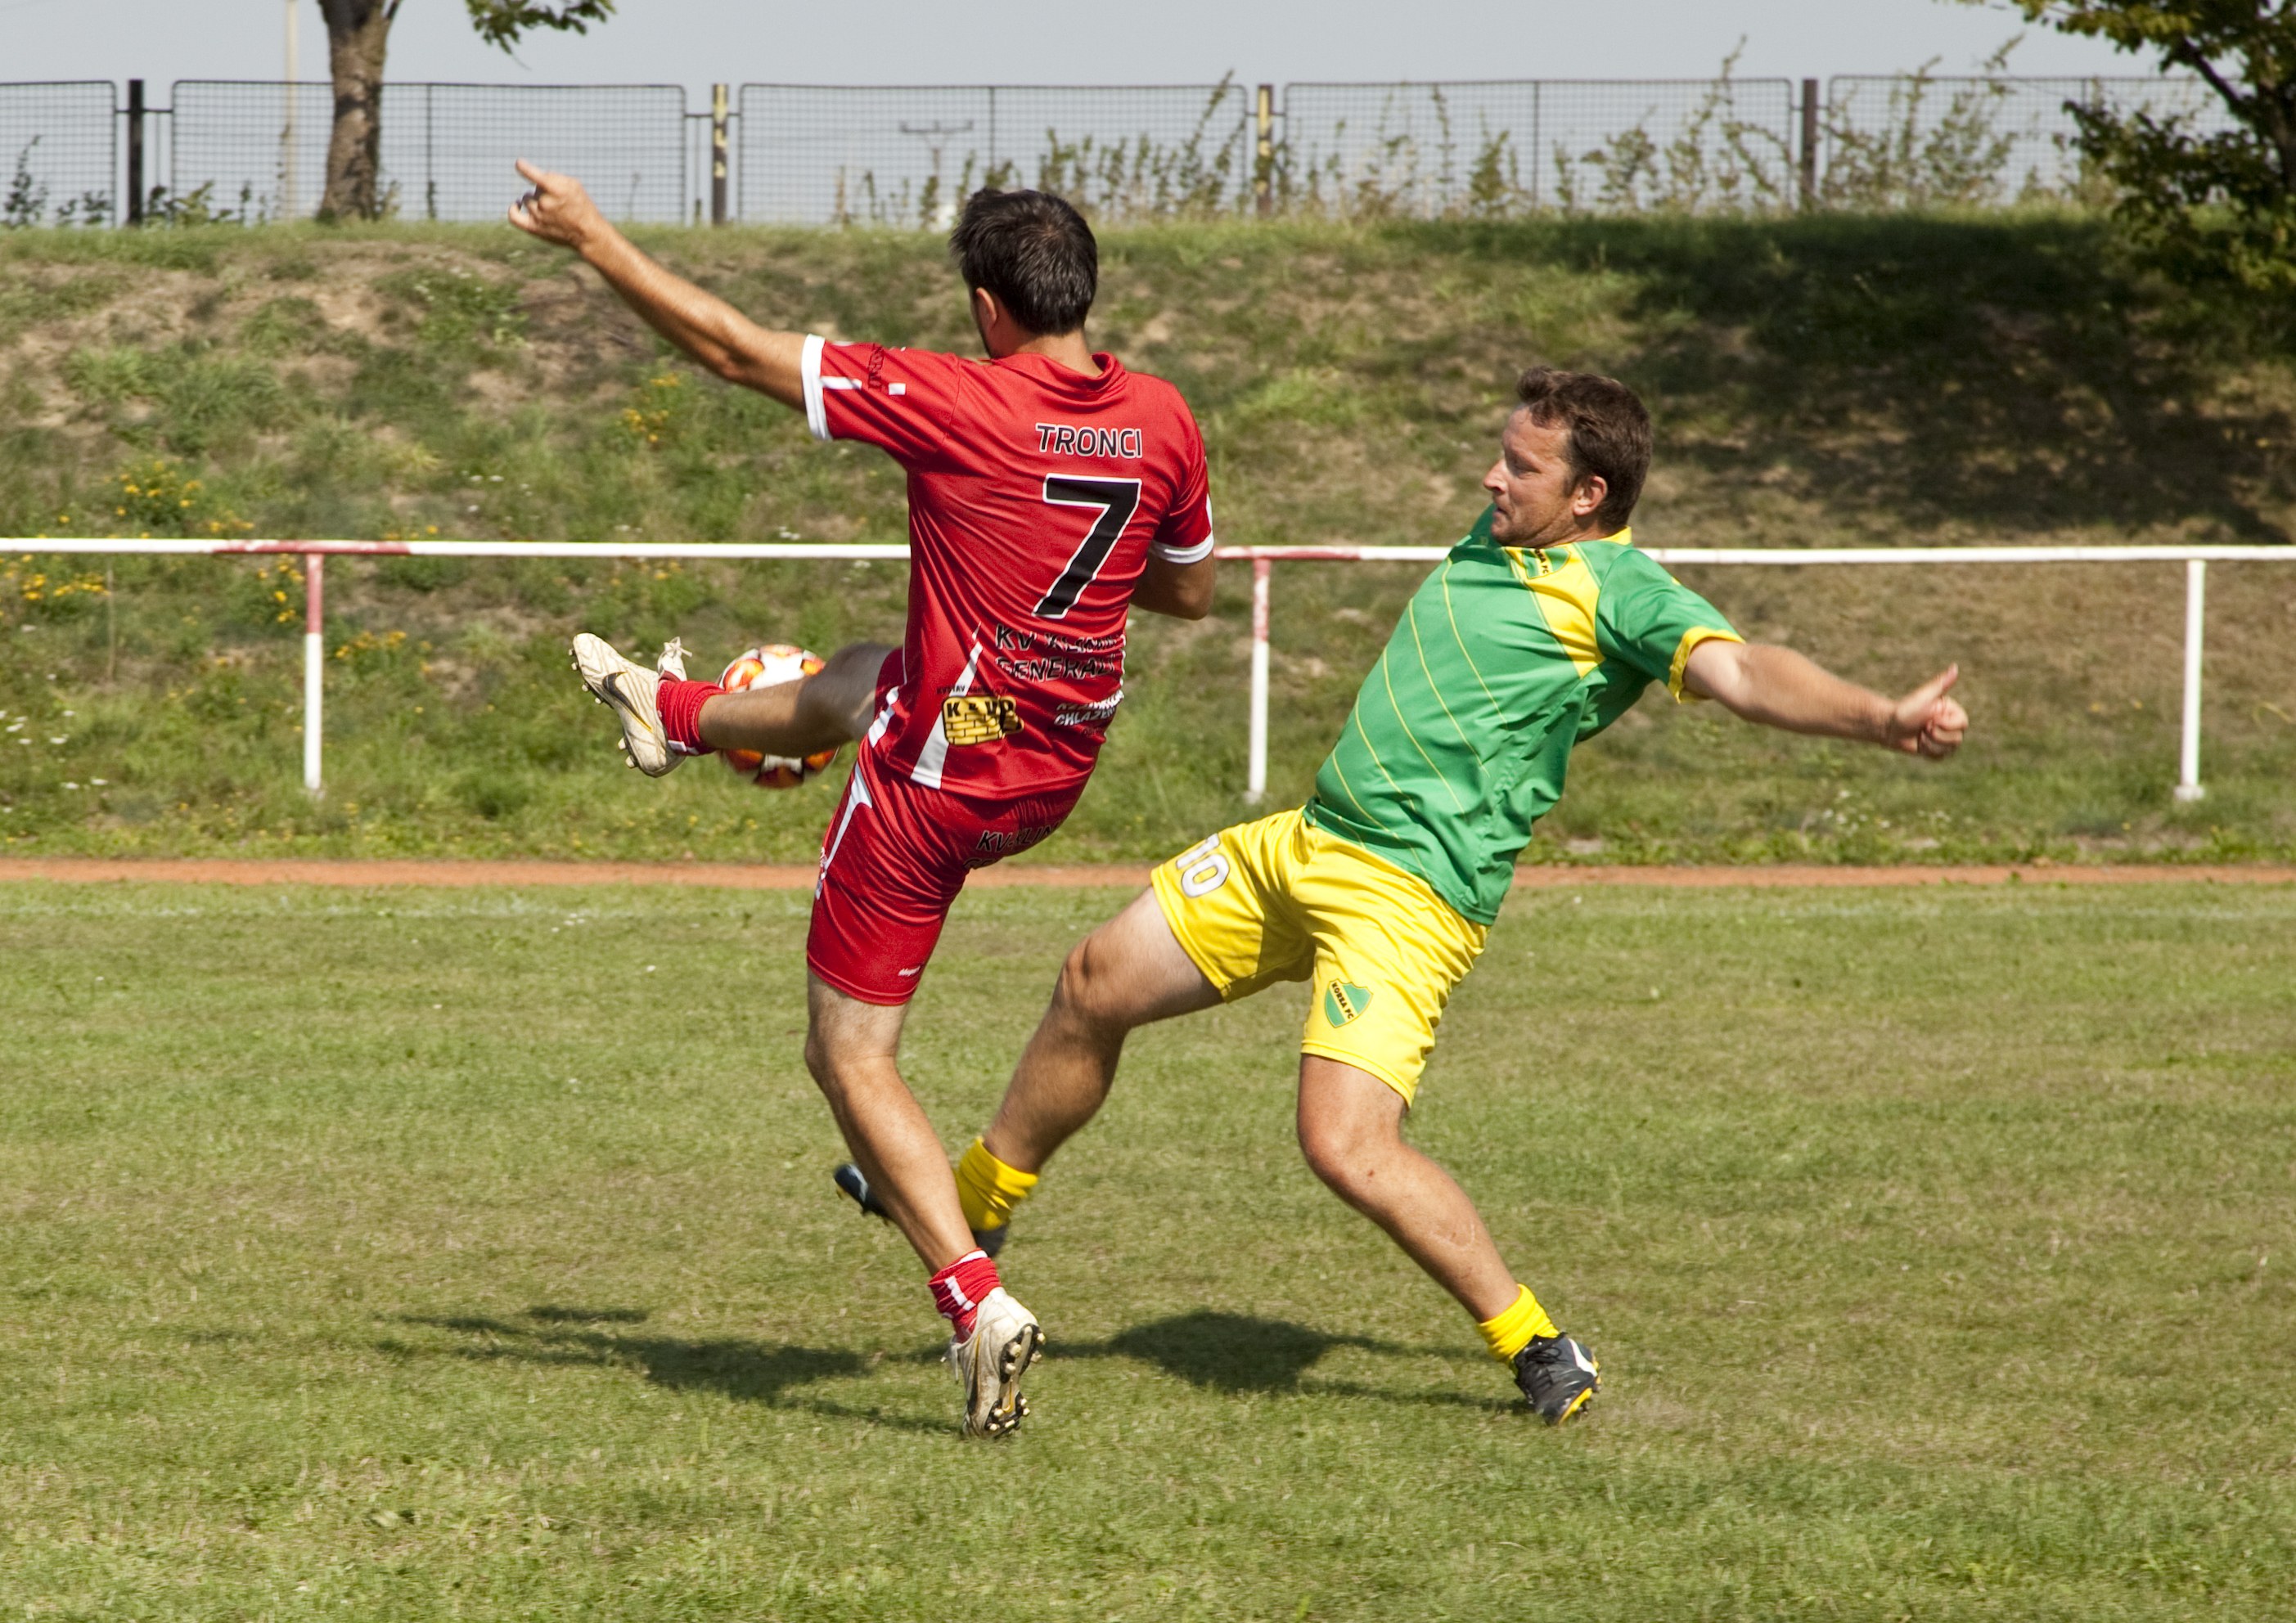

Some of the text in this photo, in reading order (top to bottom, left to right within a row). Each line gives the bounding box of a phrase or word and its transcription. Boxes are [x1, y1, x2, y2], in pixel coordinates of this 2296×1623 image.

[1036, 423, 1143, 458] TRONCI
[1031, 472, 1143, 619] 7
[995, 623, 1037, 652] KV
[1176, 833, 1230, 898] 10
